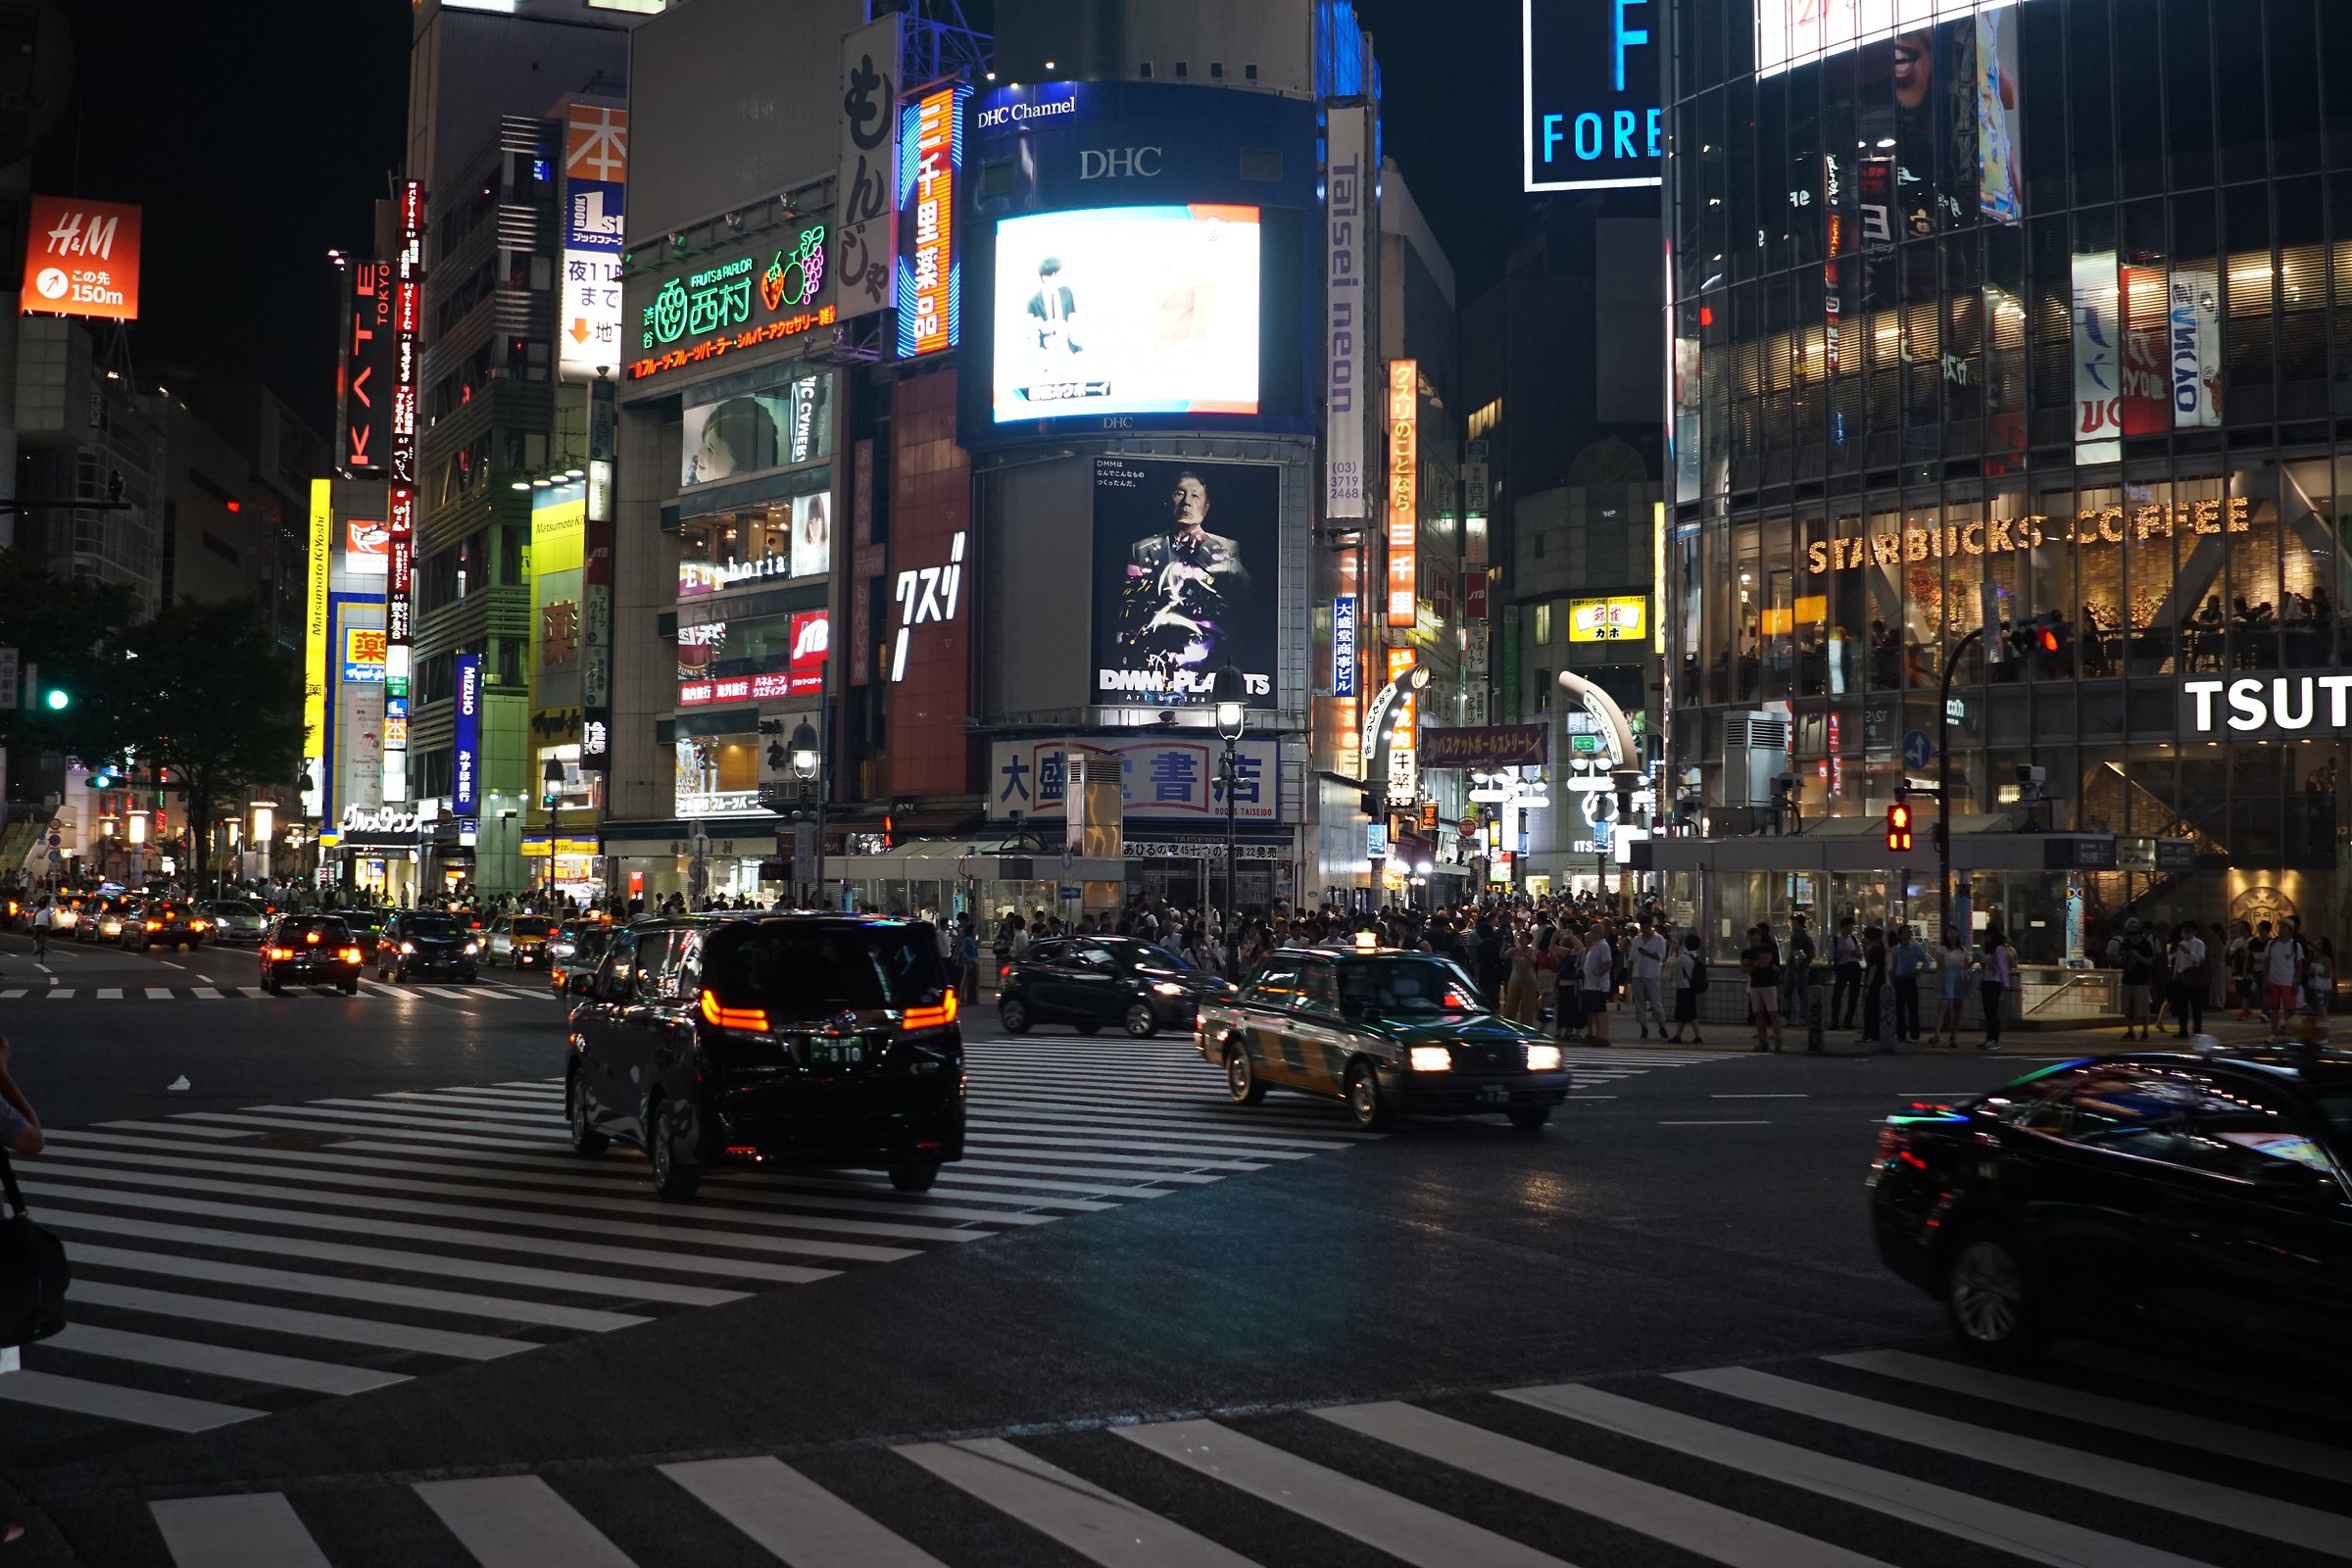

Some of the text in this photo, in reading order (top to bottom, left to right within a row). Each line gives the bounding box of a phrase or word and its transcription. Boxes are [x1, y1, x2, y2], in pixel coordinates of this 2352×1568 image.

[978, 97, 1076, 129] DHC Channel
[567, 108, 626, 181] 本
[1079, 147, 1162, 179] DHC
[839, 55, 894, 304] もんじゃ
[573, 197, 586, 227] BOOK
[913, 104, 941, 339] 三千里薬品
[47, 212, 119, 260] H&M
[72, 270, 111, 286] この先
[1332, 153, 1359, 414] Taisei neon
[72, 284, 123, 306] 150m
[377, 266, 390, 324] TOKYO
[581, 287, 619, 308] まで
[691, 276, 752, 335] 西村
[643, 307, 654, 349] 渋谷
[351, 264, 374, 465] KATE
[1102, 416, 1134, 428] DHC
[1394, 366, 1412, 511] クスリのことなら
[1097, 469, 1145, 478] なんでこんなもの
[1330, 475, 1359, 487] 3719
[1332, 462, 1357, 474] (03)
[1330, 488, 1359, 500] 2468
[536, 520, 574, 534] Matsumoto
[1808, 496, 2250, 574] STARBUCKS COFFEE
[313, 515, 325, 635] Matsumoto KiYoshi
[686, 551, 786, 591] Euphoria
[1469, 590, 1485, 600] JTB
[598, 596, 607, 627] フルーツ
[1593, 606, 1621, 622] 麻雀
[793, 618, 828, 660] JTB
[1337, 603, 1352, 692] 大盛堂商事ビル
[463, 666, 475, 715] MIZUHO
[682, 685, 711, 701] 国内旅行
[717, 681, 749, 697] 海外旅行
[755, 675, 786, 686] ハネムーン
[2184, 676, 2352, 732] TSUT
[1364, 688, 1393, 756] 渋谷センター街
[1438, 733, 1533, 755] バスケットボールストリート
[459, 751, 471, 803] みずほ銀行
[1001, 752, 1262, 804] 大盛書店
[1392, 753, 1411, 790] 牛繁
[343, 803, 419, 833] グルメタウン
[1214, 807, 1272, 817] BOOS TAISEIDO
[1175, 835, 1225, 844] TAISEIDO
